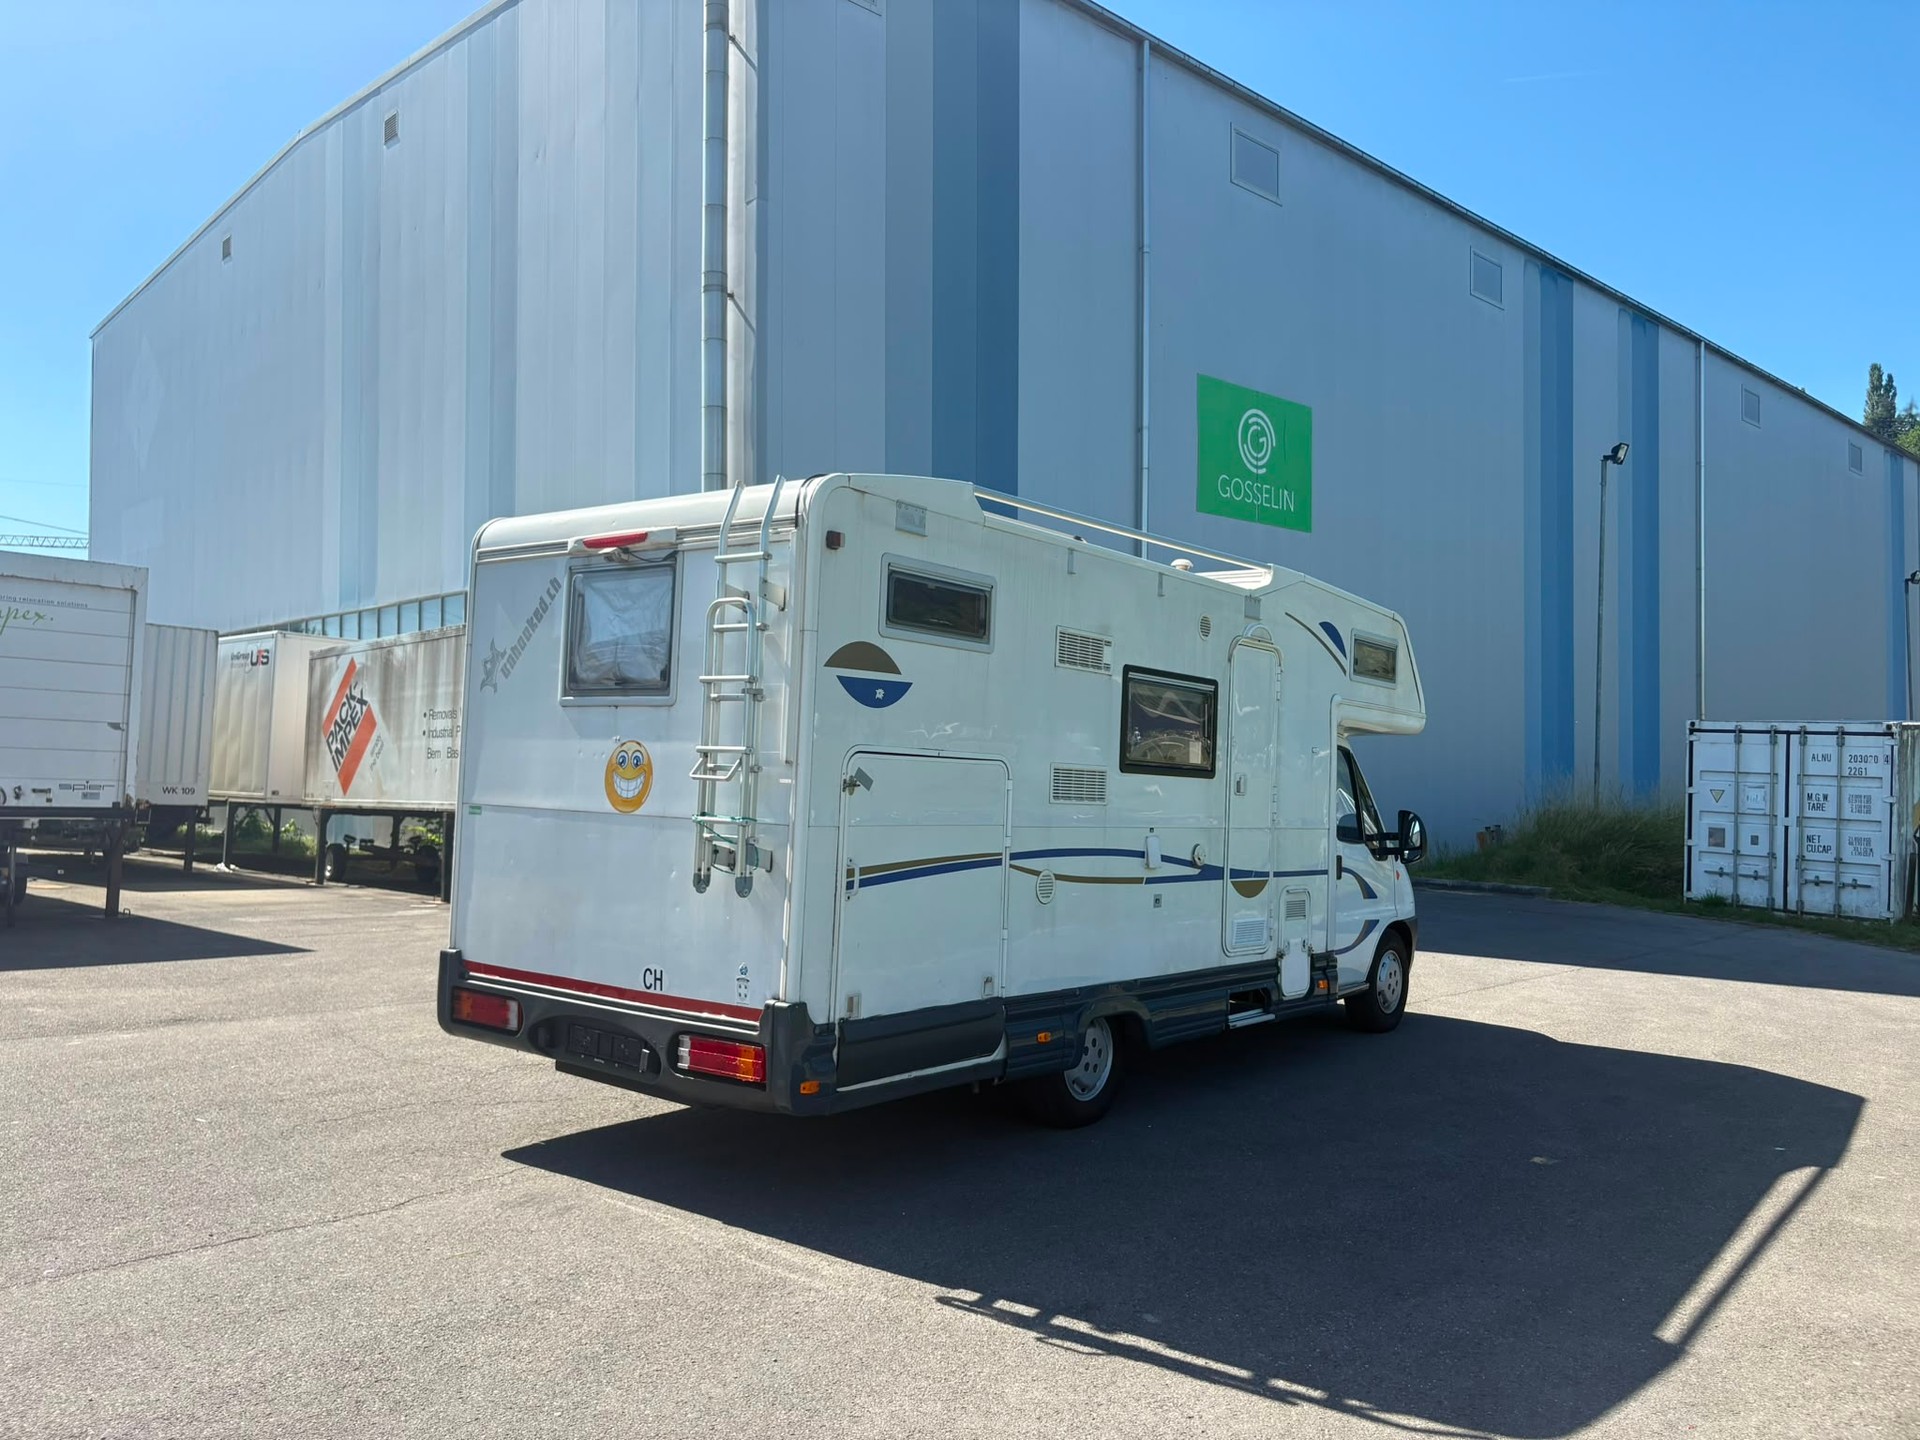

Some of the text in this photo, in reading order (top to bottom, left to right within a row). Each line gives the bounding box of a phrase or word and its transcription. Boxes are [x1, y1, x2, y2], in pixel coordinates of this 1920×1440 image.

[1217, 474, 1294, 512] GOSSELIN
[250, 648, 270, 666] UTS
[429, 708, 457, 721] Removals
[332, 687, 369, 773] IMPEX
[1811, 752, 1832, 763] ALNU
[1847, 766, 1868, 776] 22G1
[162, 786, 196, 795] WK 109
[1807, 802, 1827, 812] TARE
[1806, 834, 1821, 844] NET
[643, 968, 663, 991] CH
